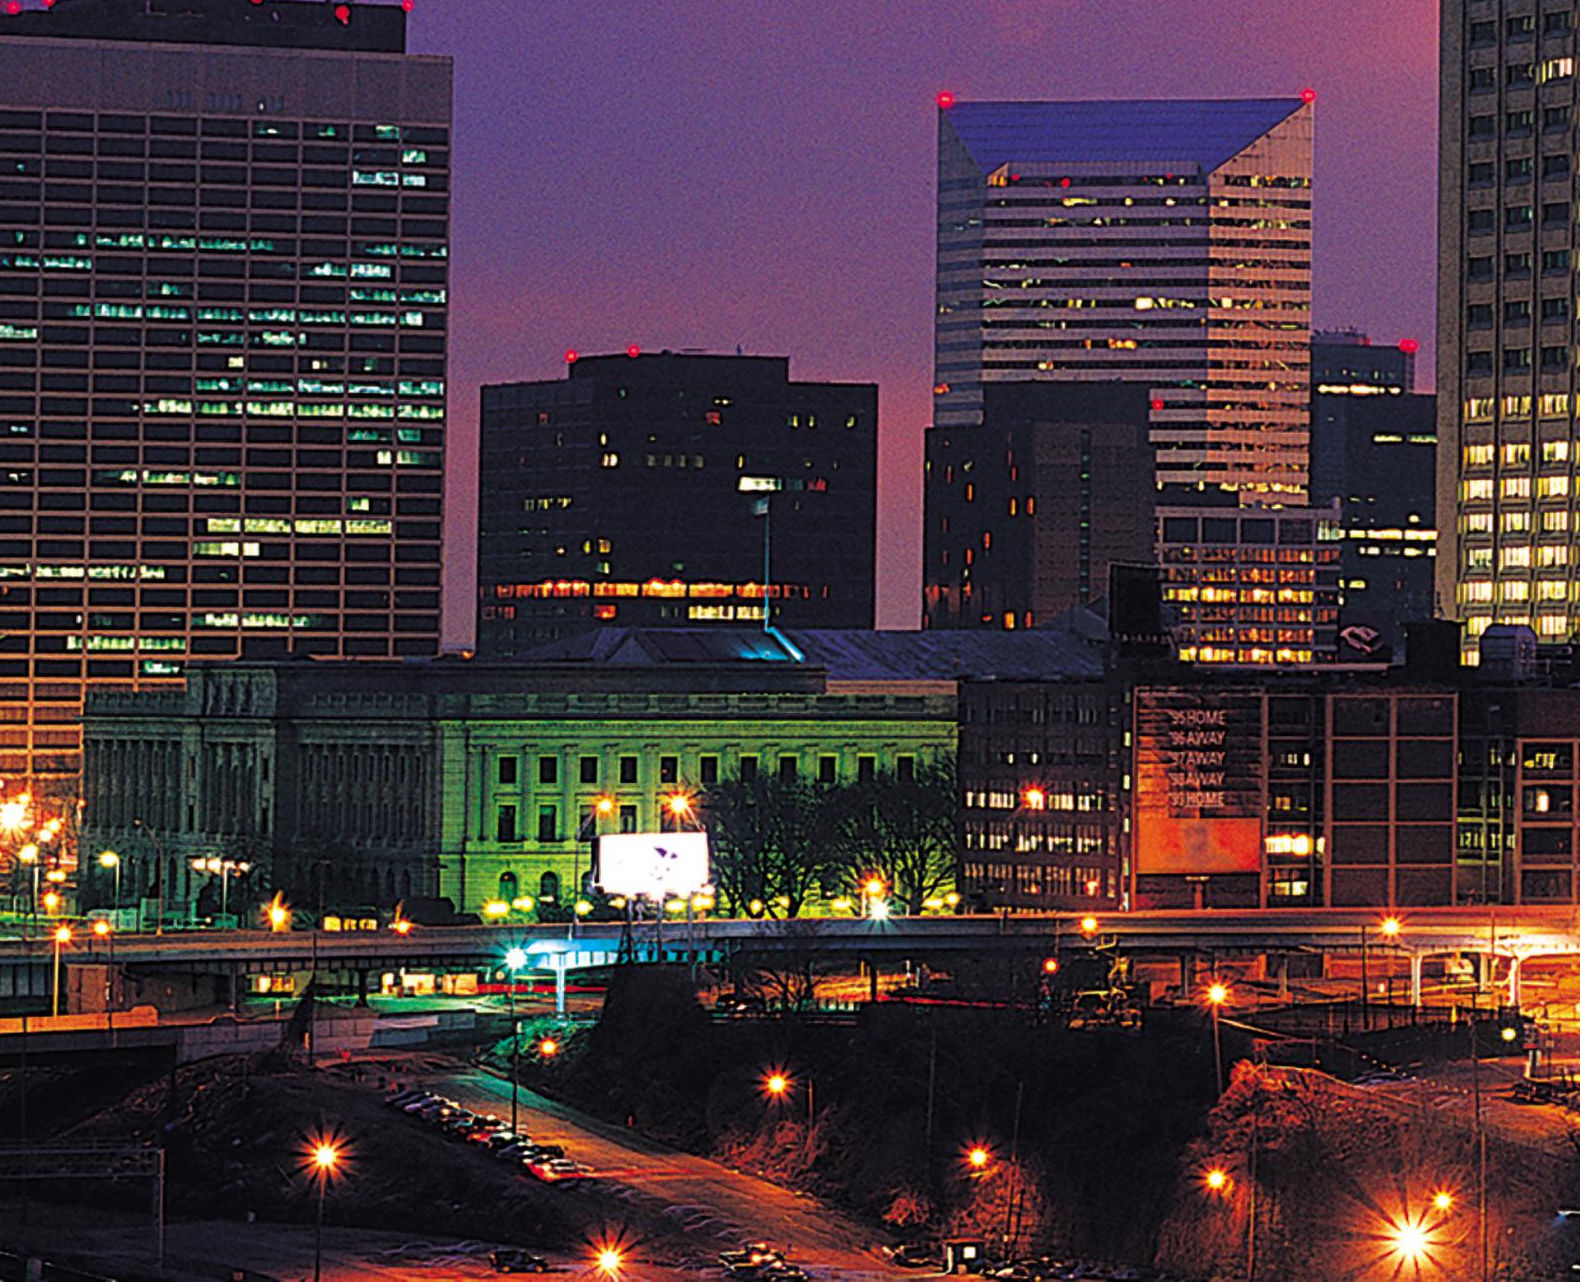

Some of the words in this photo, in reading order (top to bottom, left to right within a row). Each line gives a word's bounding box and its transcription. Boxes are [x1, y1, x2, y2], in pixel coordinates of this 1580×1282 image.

[1187, 710, 1227, 726] HOME
[1186, 730, 1225, 746] AWAY
[1186, 751, 1225, 766] AWAY
[1185, 771, 1225, 787] AWAY
[1185, 791, 1225, 808] HOME
